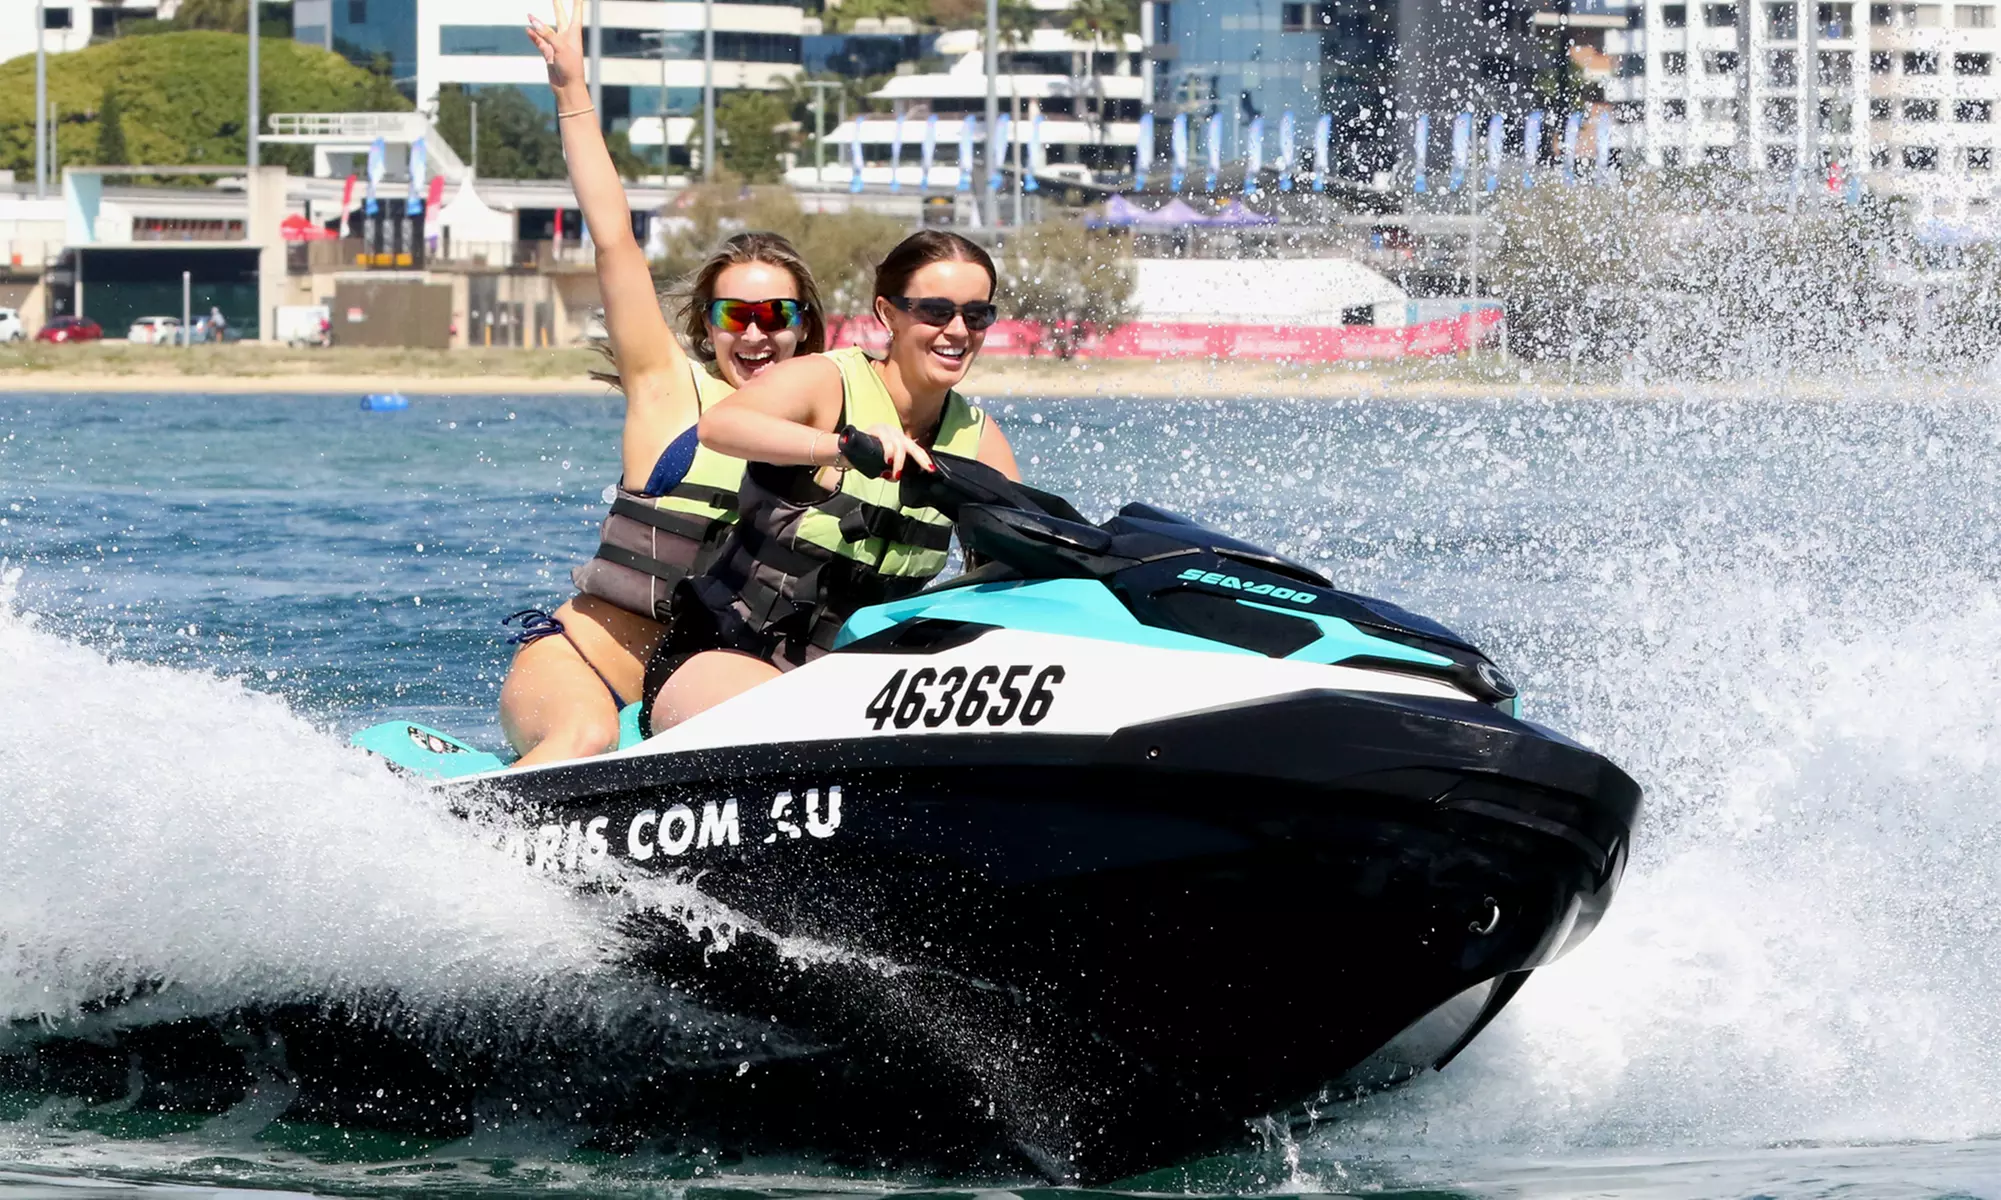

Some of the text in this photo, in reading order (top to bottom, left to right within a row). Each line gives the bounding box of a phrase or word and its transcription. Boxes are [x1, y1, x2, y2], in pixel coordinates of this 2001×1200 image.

[865, 665, 1066, 730] 463656
[627, 798, 740, 861] COM
[763, 785, 842, 843] AU
